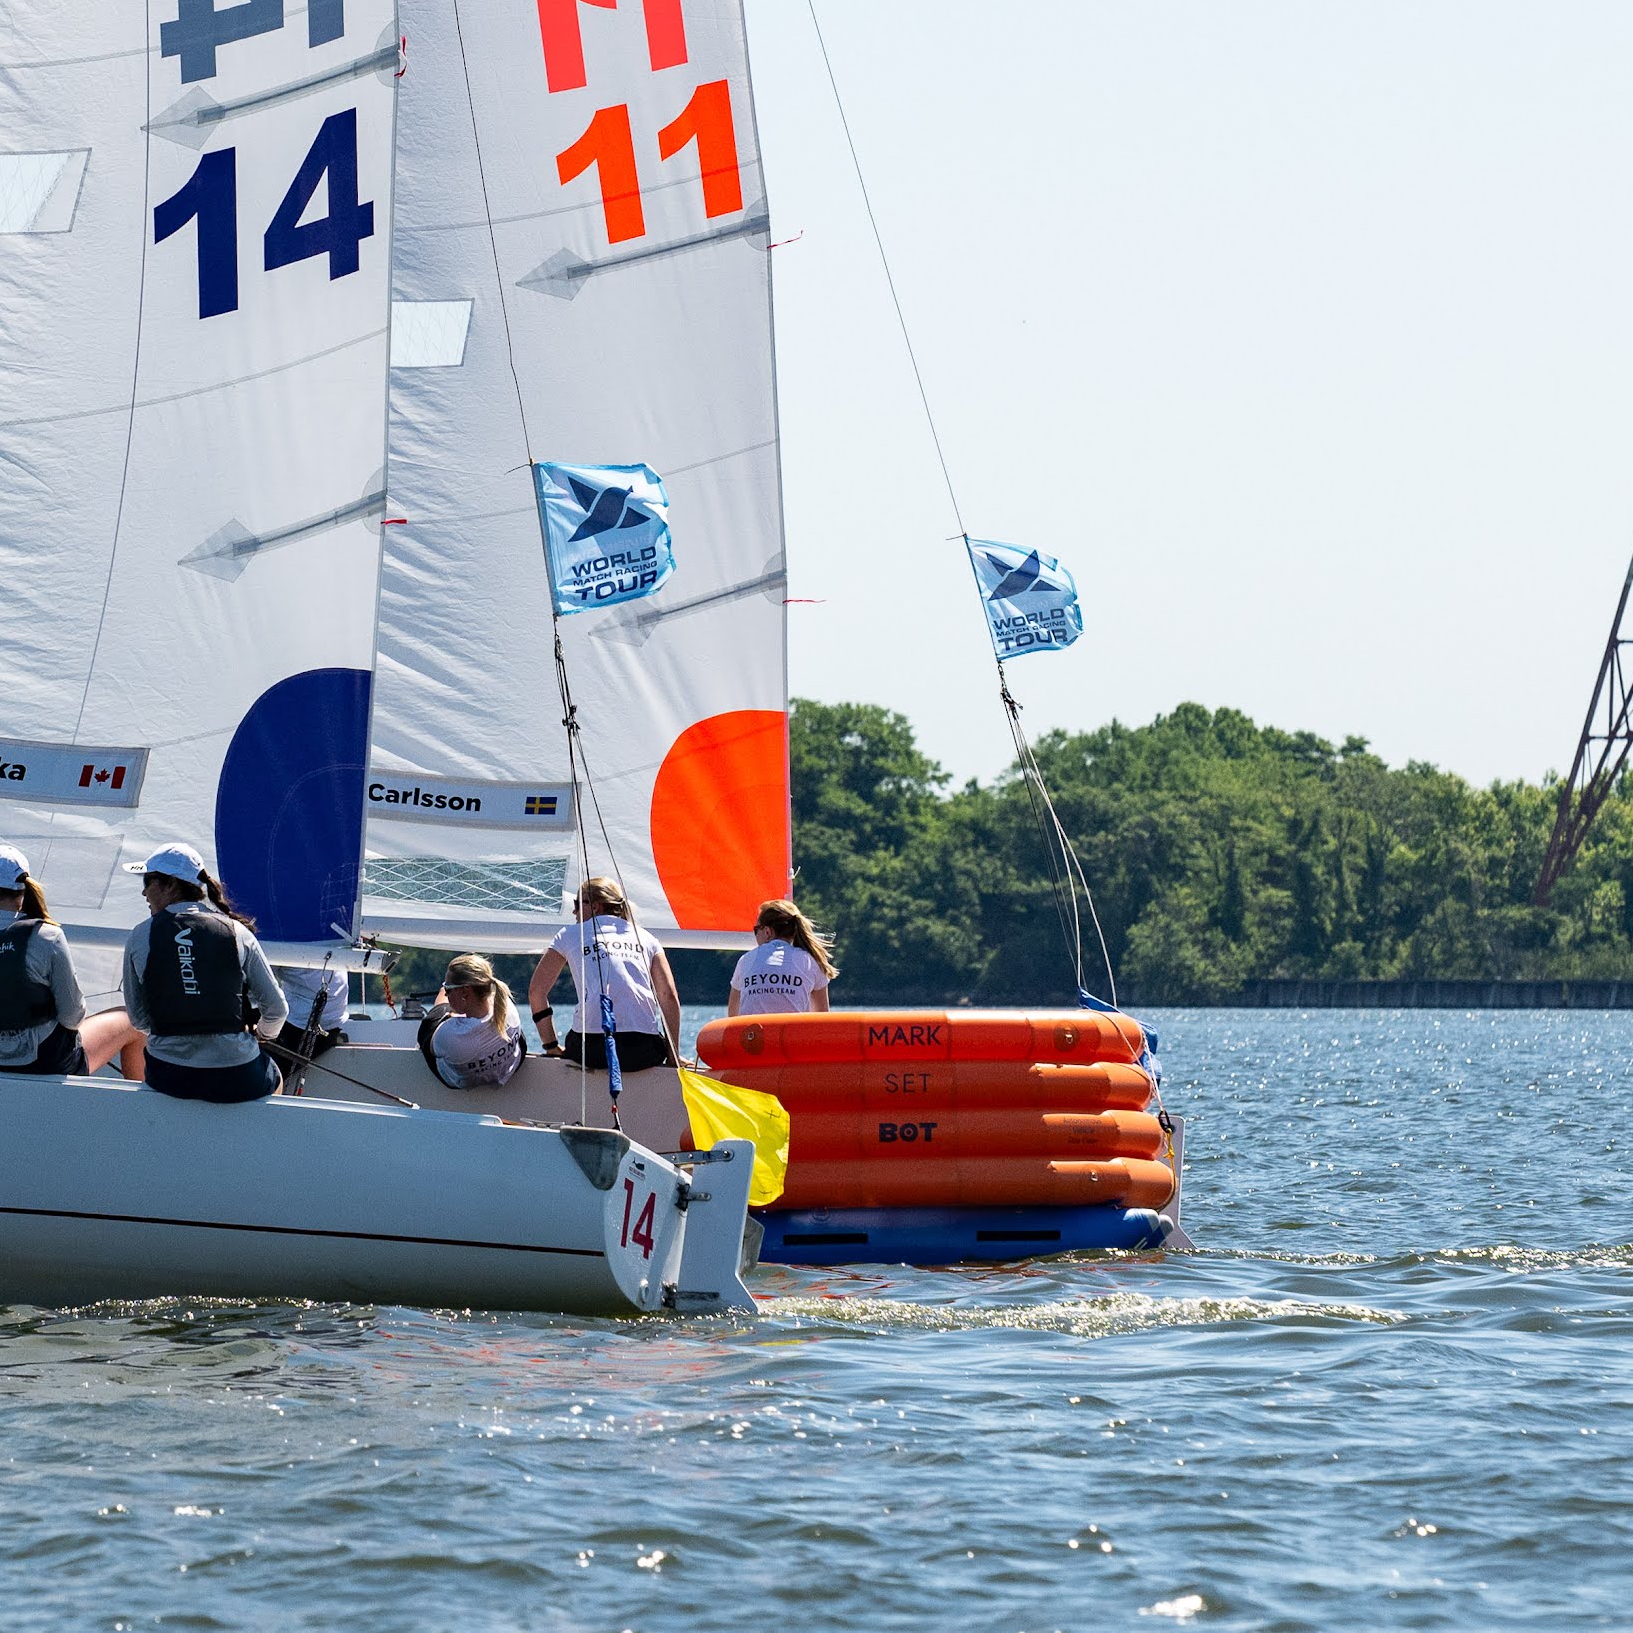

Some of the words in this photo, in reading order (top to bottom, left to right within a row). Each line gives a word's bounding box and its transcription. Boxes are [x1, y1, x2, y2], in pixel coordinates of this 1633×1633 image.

[556, 79, 743, 244] 11
[154, 107, 374, 319] 14
[572, 547, 657, 577] WORLD
[573, 572, 612, 586] MATCH
[615, 561, 658, 576] RACING
[575, 570, 658, 600] TOUR
[993, 608, 1065, 629] WORLD
[998, 628, 1068, 650] TOUR
[368, 784, 481, 811] Carlsson
[583, 941, 644, 956] BEYOND
[174, 928, 200, 995] Vaikobi
[744, 974, 803, 987] BEYOND
[749, 987, 775, 995] RACING
[869, 1026, 941, 1046] MARK
[885, 1073, 931, 1093] SET
[879, 1122, 938, 1142] BOT
[621, 1178, 656, 1259] 14
